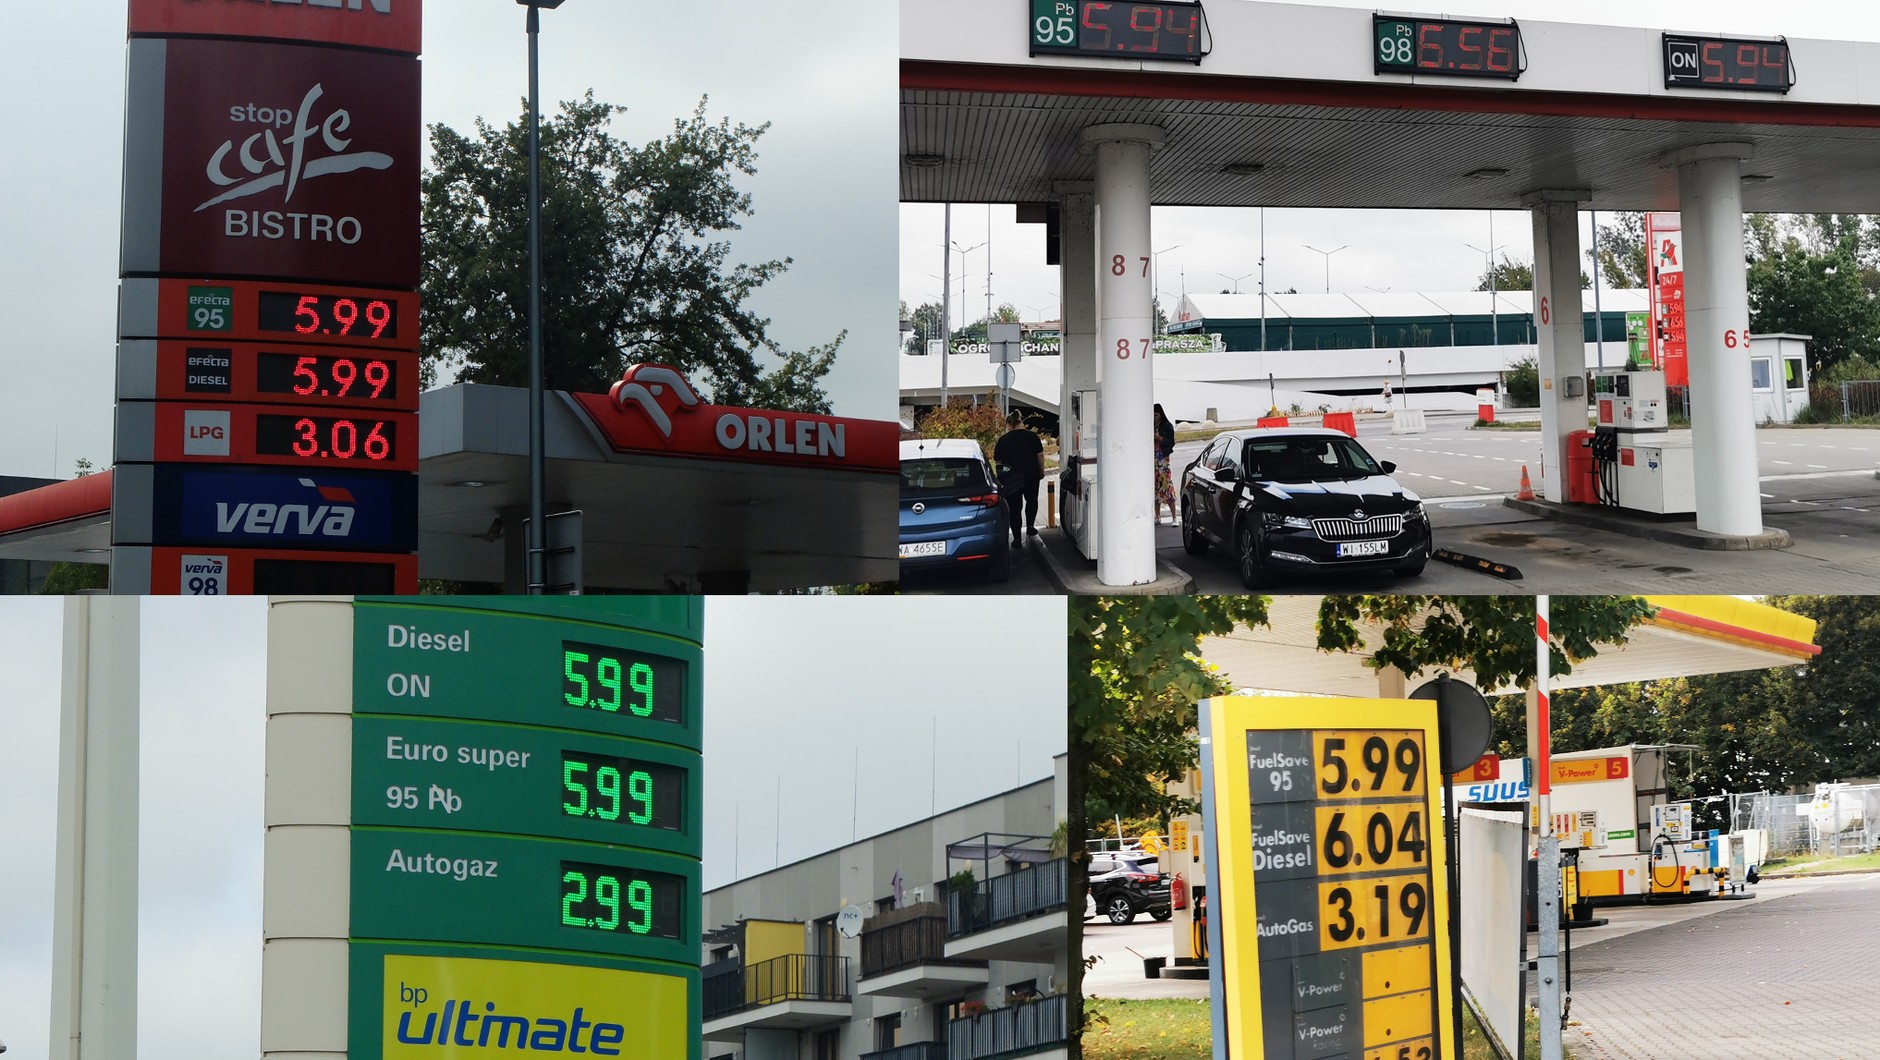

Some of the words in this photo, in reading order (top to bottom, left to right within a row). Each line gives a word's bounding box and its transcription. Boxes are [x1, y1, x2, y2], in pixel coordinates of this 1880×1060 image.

[1055, 3, 1074, 15] Pb
[1036, 16, 1074, 44] 95
[1082, 3, 1197, 53] 5.94
[1396, 25, 1412, 37] Pb
[1380, 37, 1412, 63] 98
[1417, 24, 1512, 72] 6.56
[1671, 52, 1696, 68] ON
[1702, 42, 1785, 84] 5.94
[230, 103, 292, 128] stop
[206, 83, 352, 204] cafe
[225, 209, 362, 244] BISTRO
[1112, 254, 1125, 277] 8
[1139, 256, 1150, 278] 7
[194, 308, 225, 329] 95
[294, 296, 390, 338] 5.99
[1540, 296, 1549, 325] 6
[1116, 338, 1130, 360] 8
[1139, 338, 1150, 360] 7
[1724, 330, 1737, 348] 6
[189, 376, 228, 386] DIESEL
[293, 357, 389, 398] 5.99
[190, 426, 224, 439] LPG
[293, 418, 389, 460] 3.06
[715, 414, 846, 458] ORLEN
[216, 502, 355, 536] verva
[913, 543, 943, 554] 4655E
[185, 564, 222, 574] verva
[189, 577, 218, 595] 98
[387, 624, 470, 652] Diesel
[386, 673, 430, 698] ON
[565, 651, 653, 717] 5.99
[386, 736, 448, 763] Euro
[457, 746, 530, 771] super
[1249, 752, 1309, 769] FuelSave
[1322, 736, 1420, 794] 5.99
[1480, 759, 1492, 776] 3
[1558, 769, 1597, 778] V-Power
[1611, 761, 1622, 776] 5
[564, 760, 652, 825] 5.99
[1270, 771, 1293, 791] 95
[1468, 781, 1530, 802] SUUS
[386, 786, 418, 809] 95
[1252, 829, 1310, 847] FuelSave
[1323, 811, 1425, 868] 6.04
[386, 849, 498, 881] Autogaz
[1253, 844, 1312, 870] Diesel
[562, 871, 652, 934] 2.99
[1328, 882, 1426, 942] 3.19
[1257, 918, 1313, 937] AutoGas
[400, 982, 428, 1007] bp
[1298, 983, 1343, 998] V-Power
[397, 999, 625, 1056] ultimate
[1298, 1024, 1344, 1040] V-Power
